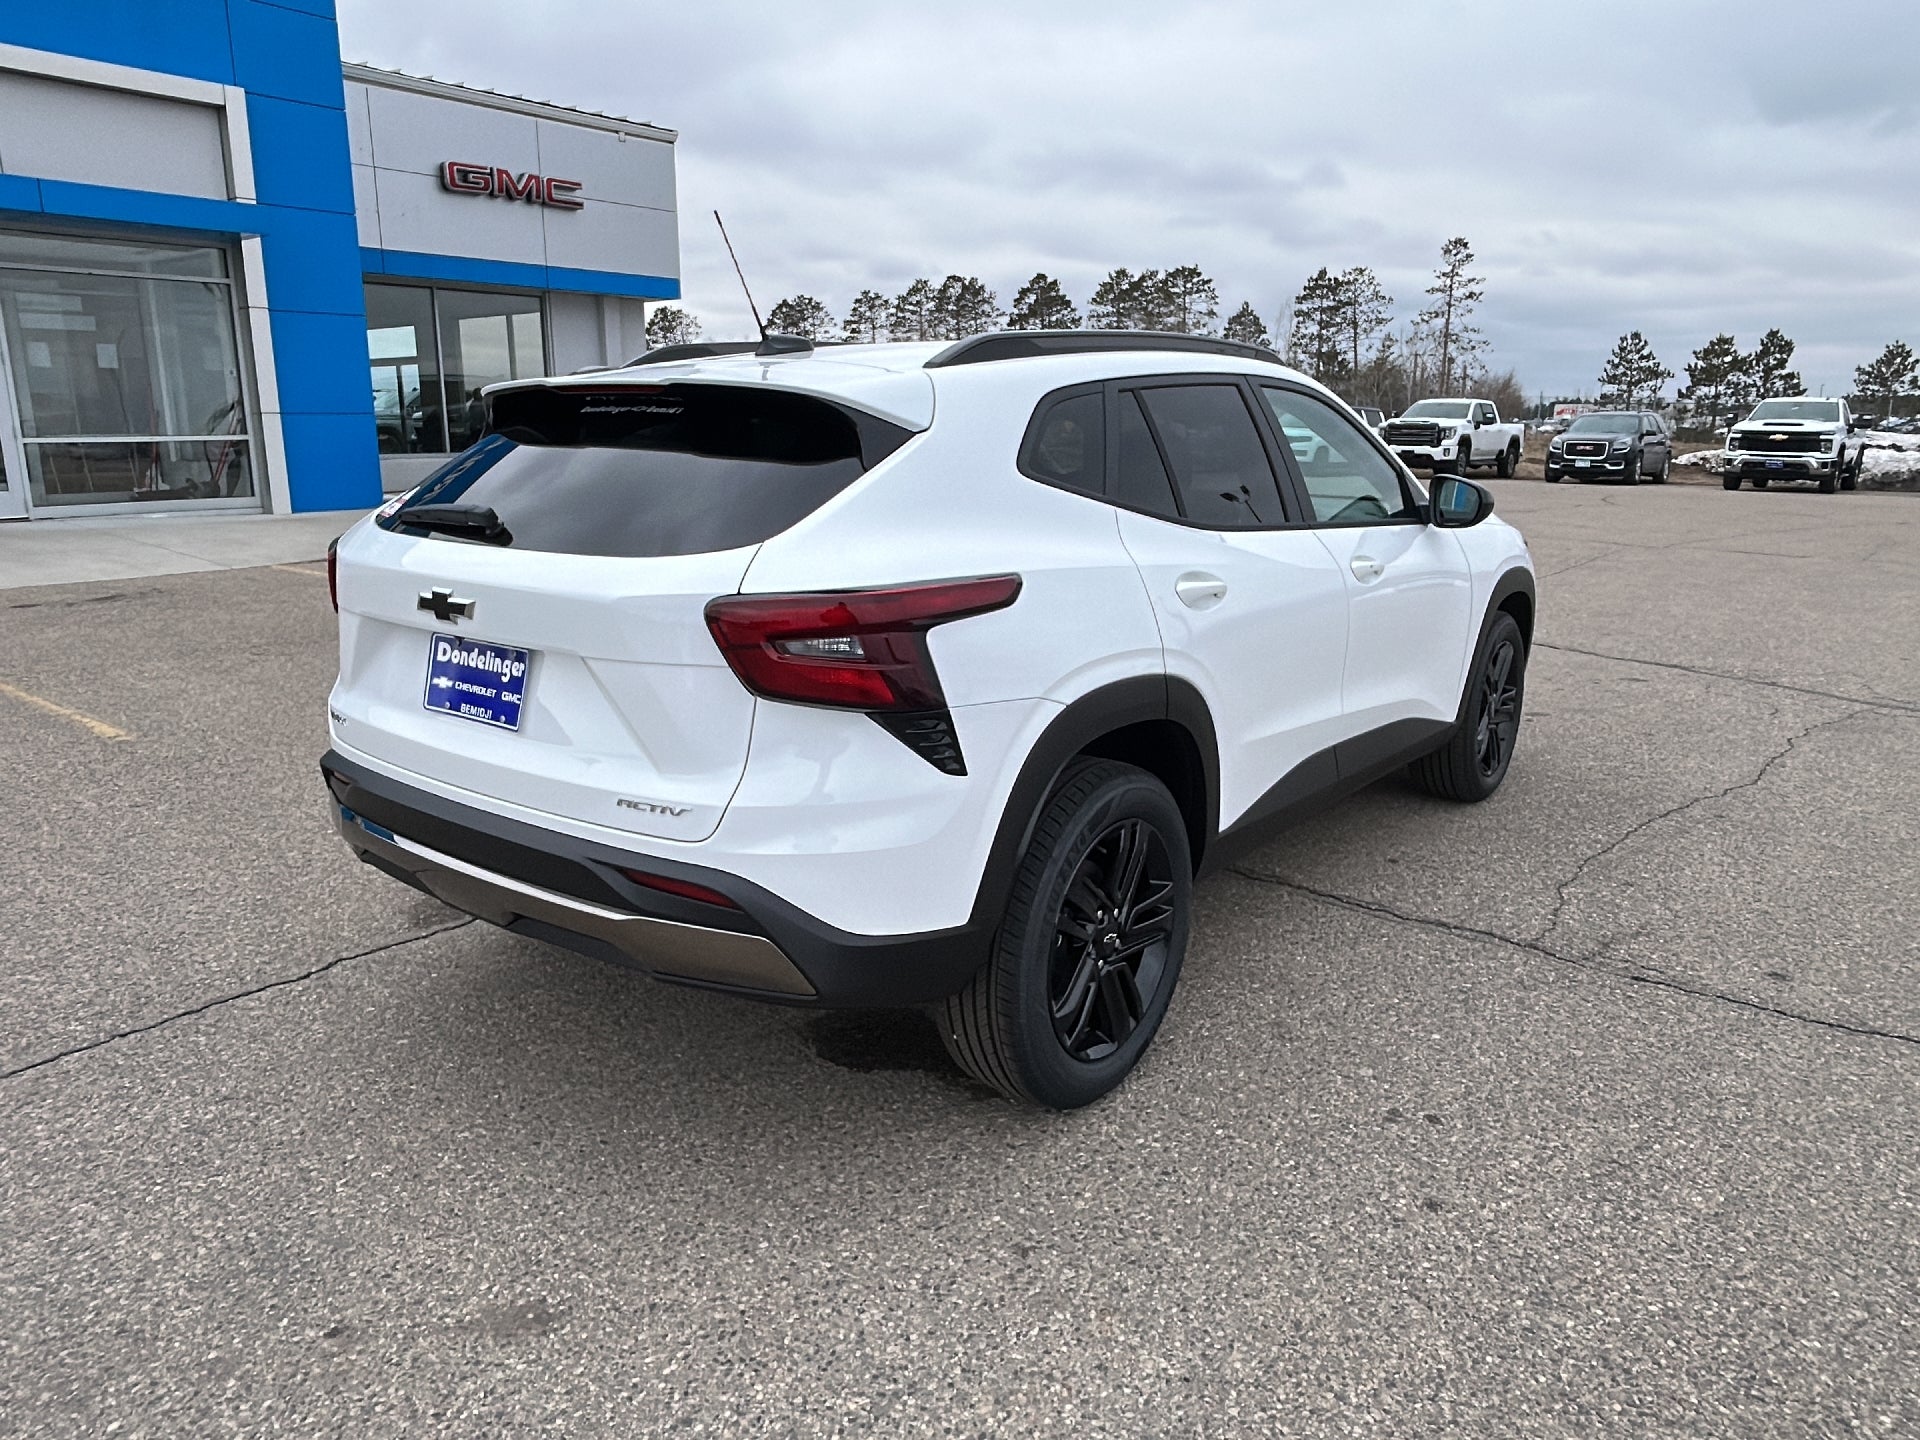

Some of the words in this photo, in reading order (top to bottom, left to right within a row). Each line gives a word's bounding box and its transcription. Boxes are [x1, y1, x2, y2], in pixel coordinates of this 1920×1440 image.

[441, 160, 584, 210] GMC
[437, 641, 525, 682] Dondelinger
[455, 681, 497, 698] CHEVROLET
[501, 691, 521, 704] GMC
[460, 703, 492, 718] BEMIDJI
[616, 798, 693, 817] ACTIV
